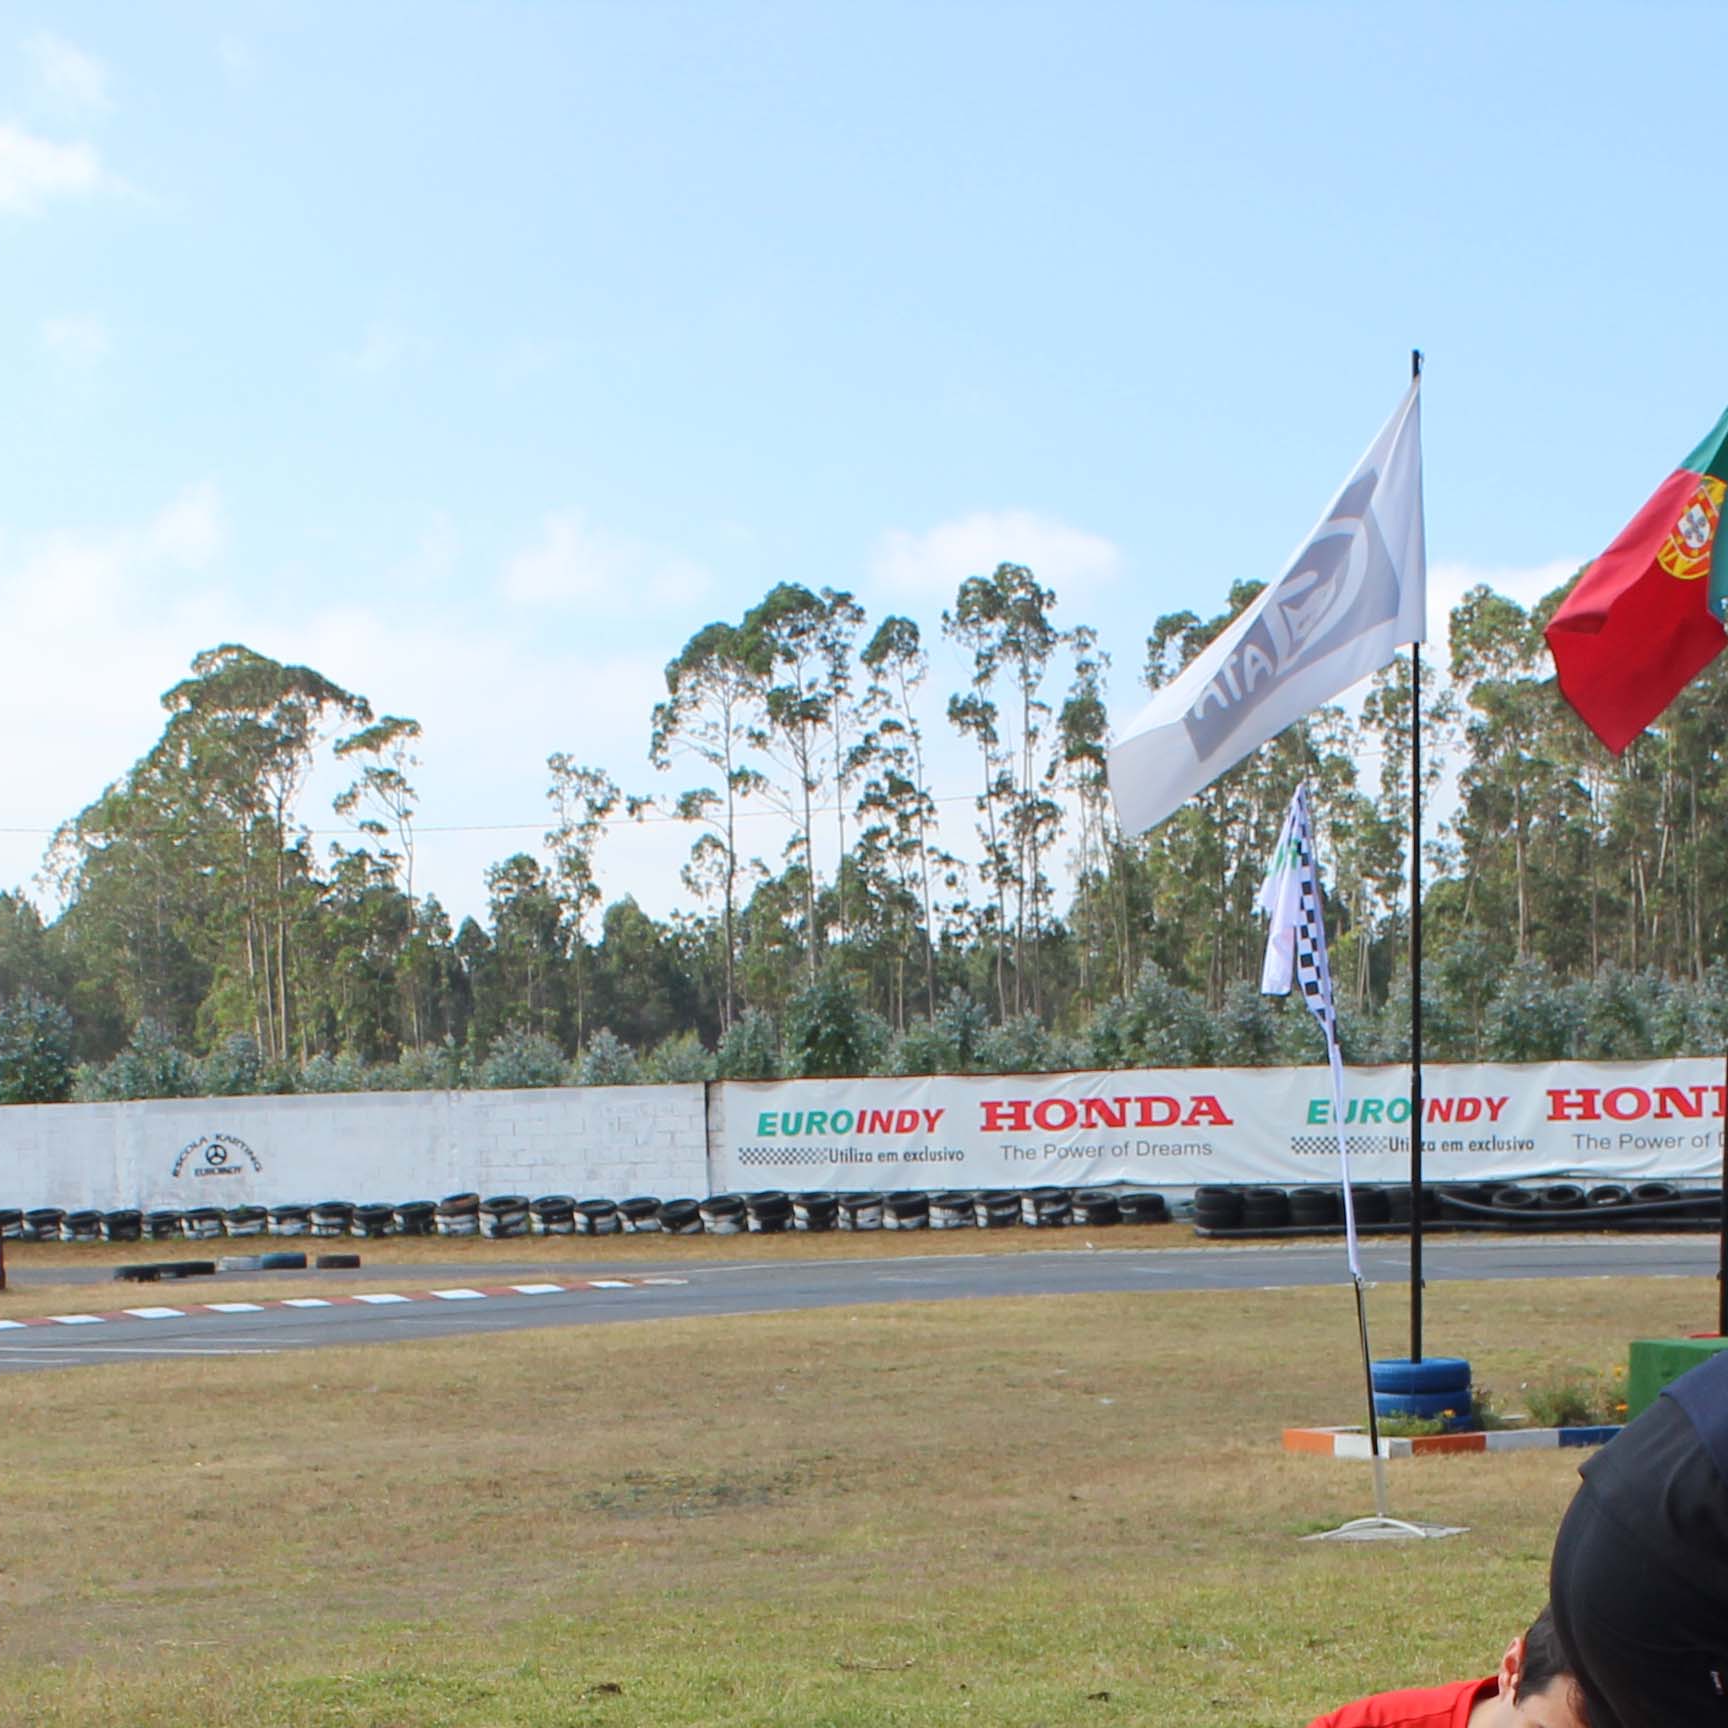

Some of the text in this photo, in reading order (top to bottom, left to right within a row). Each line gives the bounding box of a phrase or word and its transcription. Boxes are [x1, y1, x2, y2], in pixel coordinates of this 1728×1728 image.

[757, 1108, 945, 1137] EUROINDY
[980, 1096, 1233, 1132] HONDA
[1001, 1140, 1213, 1160] The Power of Dreams
[1441, 1141, 1463, 1152] em
[1467, 1137, 1536, 1152] exclusivo
[1573, 1133, 1612, 1150] The
[1618, 1131, 1683, 1149] Power
[1690, 1131, 1711, 1147] of
[829, 1147, 965, 1164] Utiliza em exclusivo
